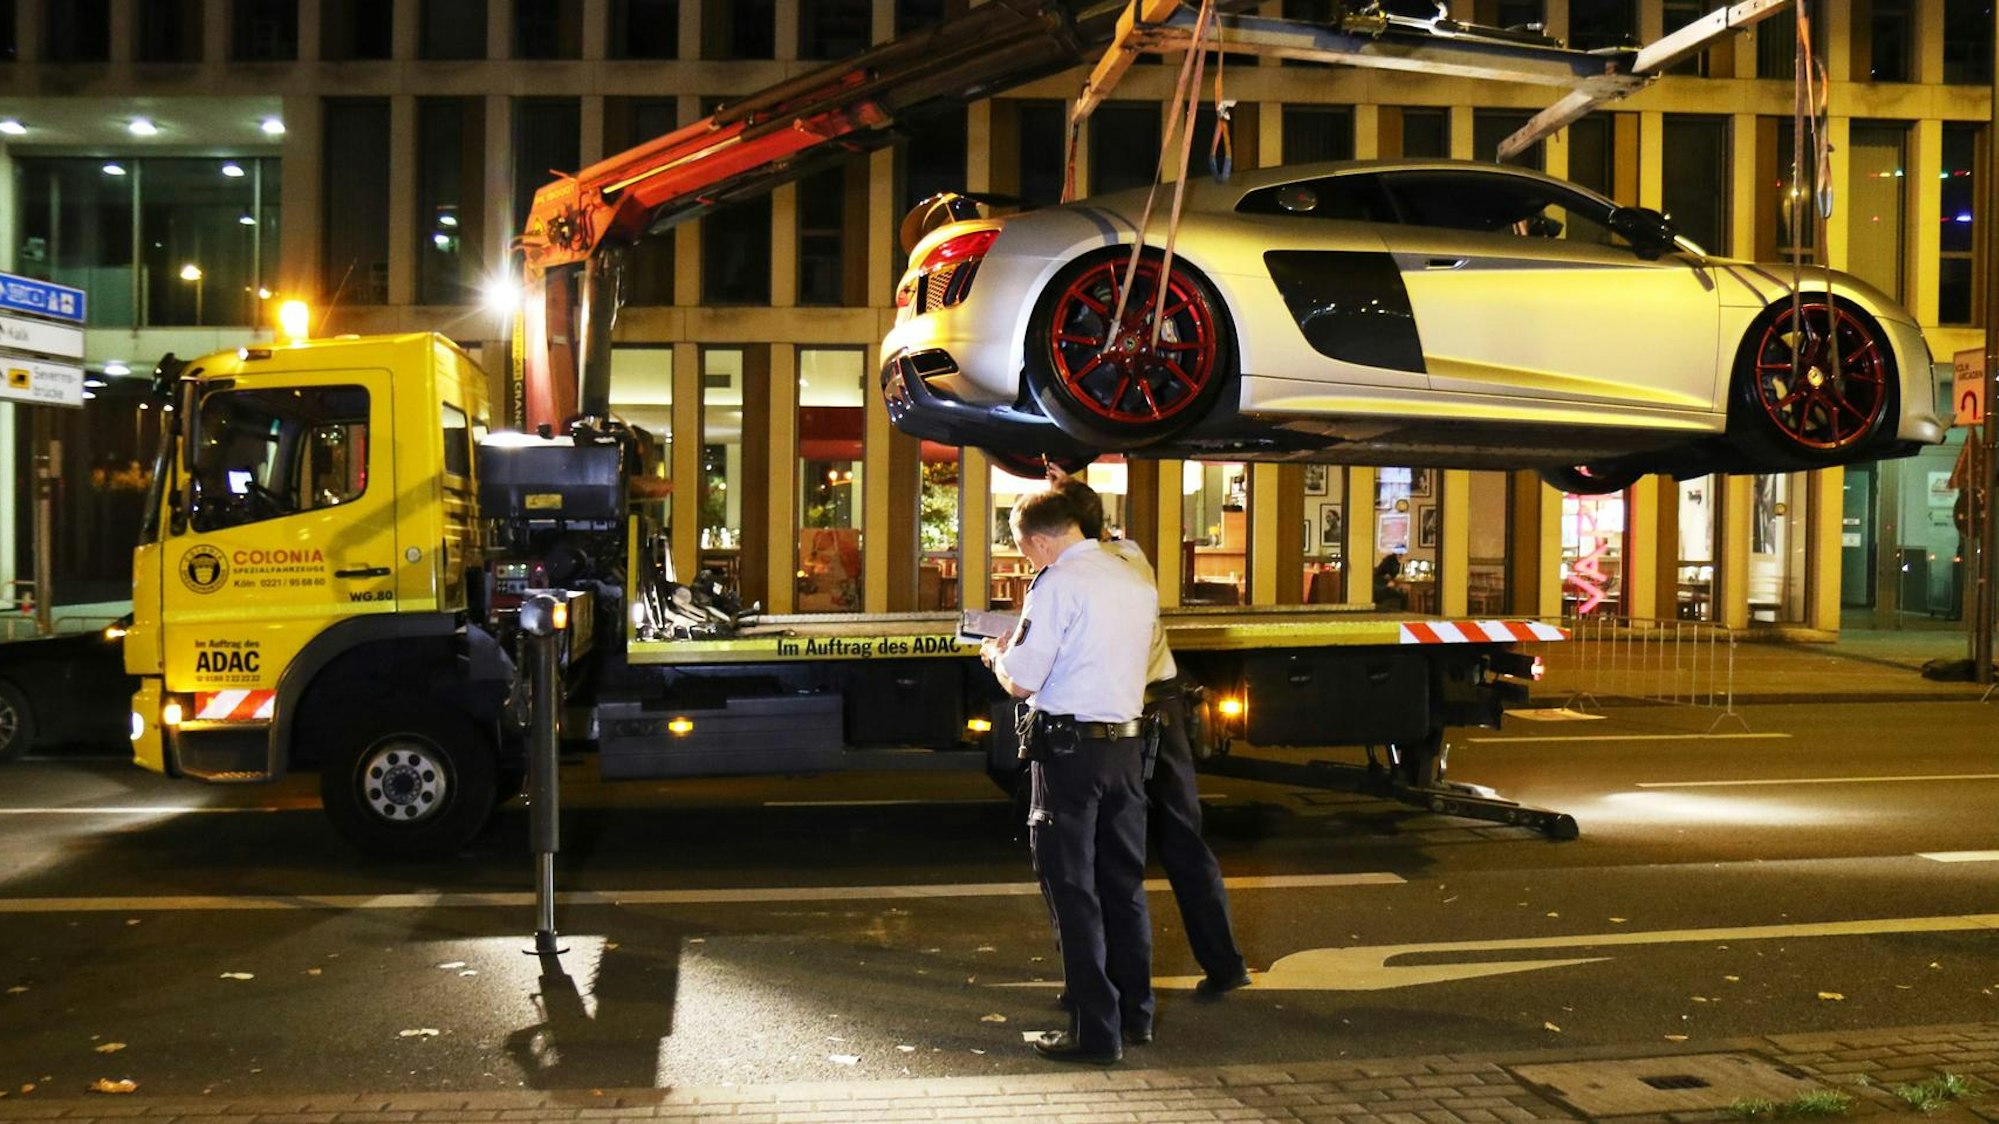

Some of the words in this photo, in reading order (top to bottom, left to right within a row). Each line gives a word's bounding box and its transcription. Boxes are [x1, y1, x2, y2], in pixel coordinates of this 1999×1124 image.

[233, 549, 324, 565] COLONIA
[233, 565, 324, 574] SPEZIALFAHRZEUGE
[234, 579, 256, 588] Köln
[349, 590, 393, 602] WG.80
[195, 640, 206, 648] Im
[209, 640, 241, 649] Auftrag
[244, 640, 260, 648] des
[777, 638, 798, 657] Im
[805, 638, 872, 657] Auftrag
[878, 637, 909, 655] des
[913, 636, 961, 654] ADAC
[196, 651, 260, 672] ADAC
